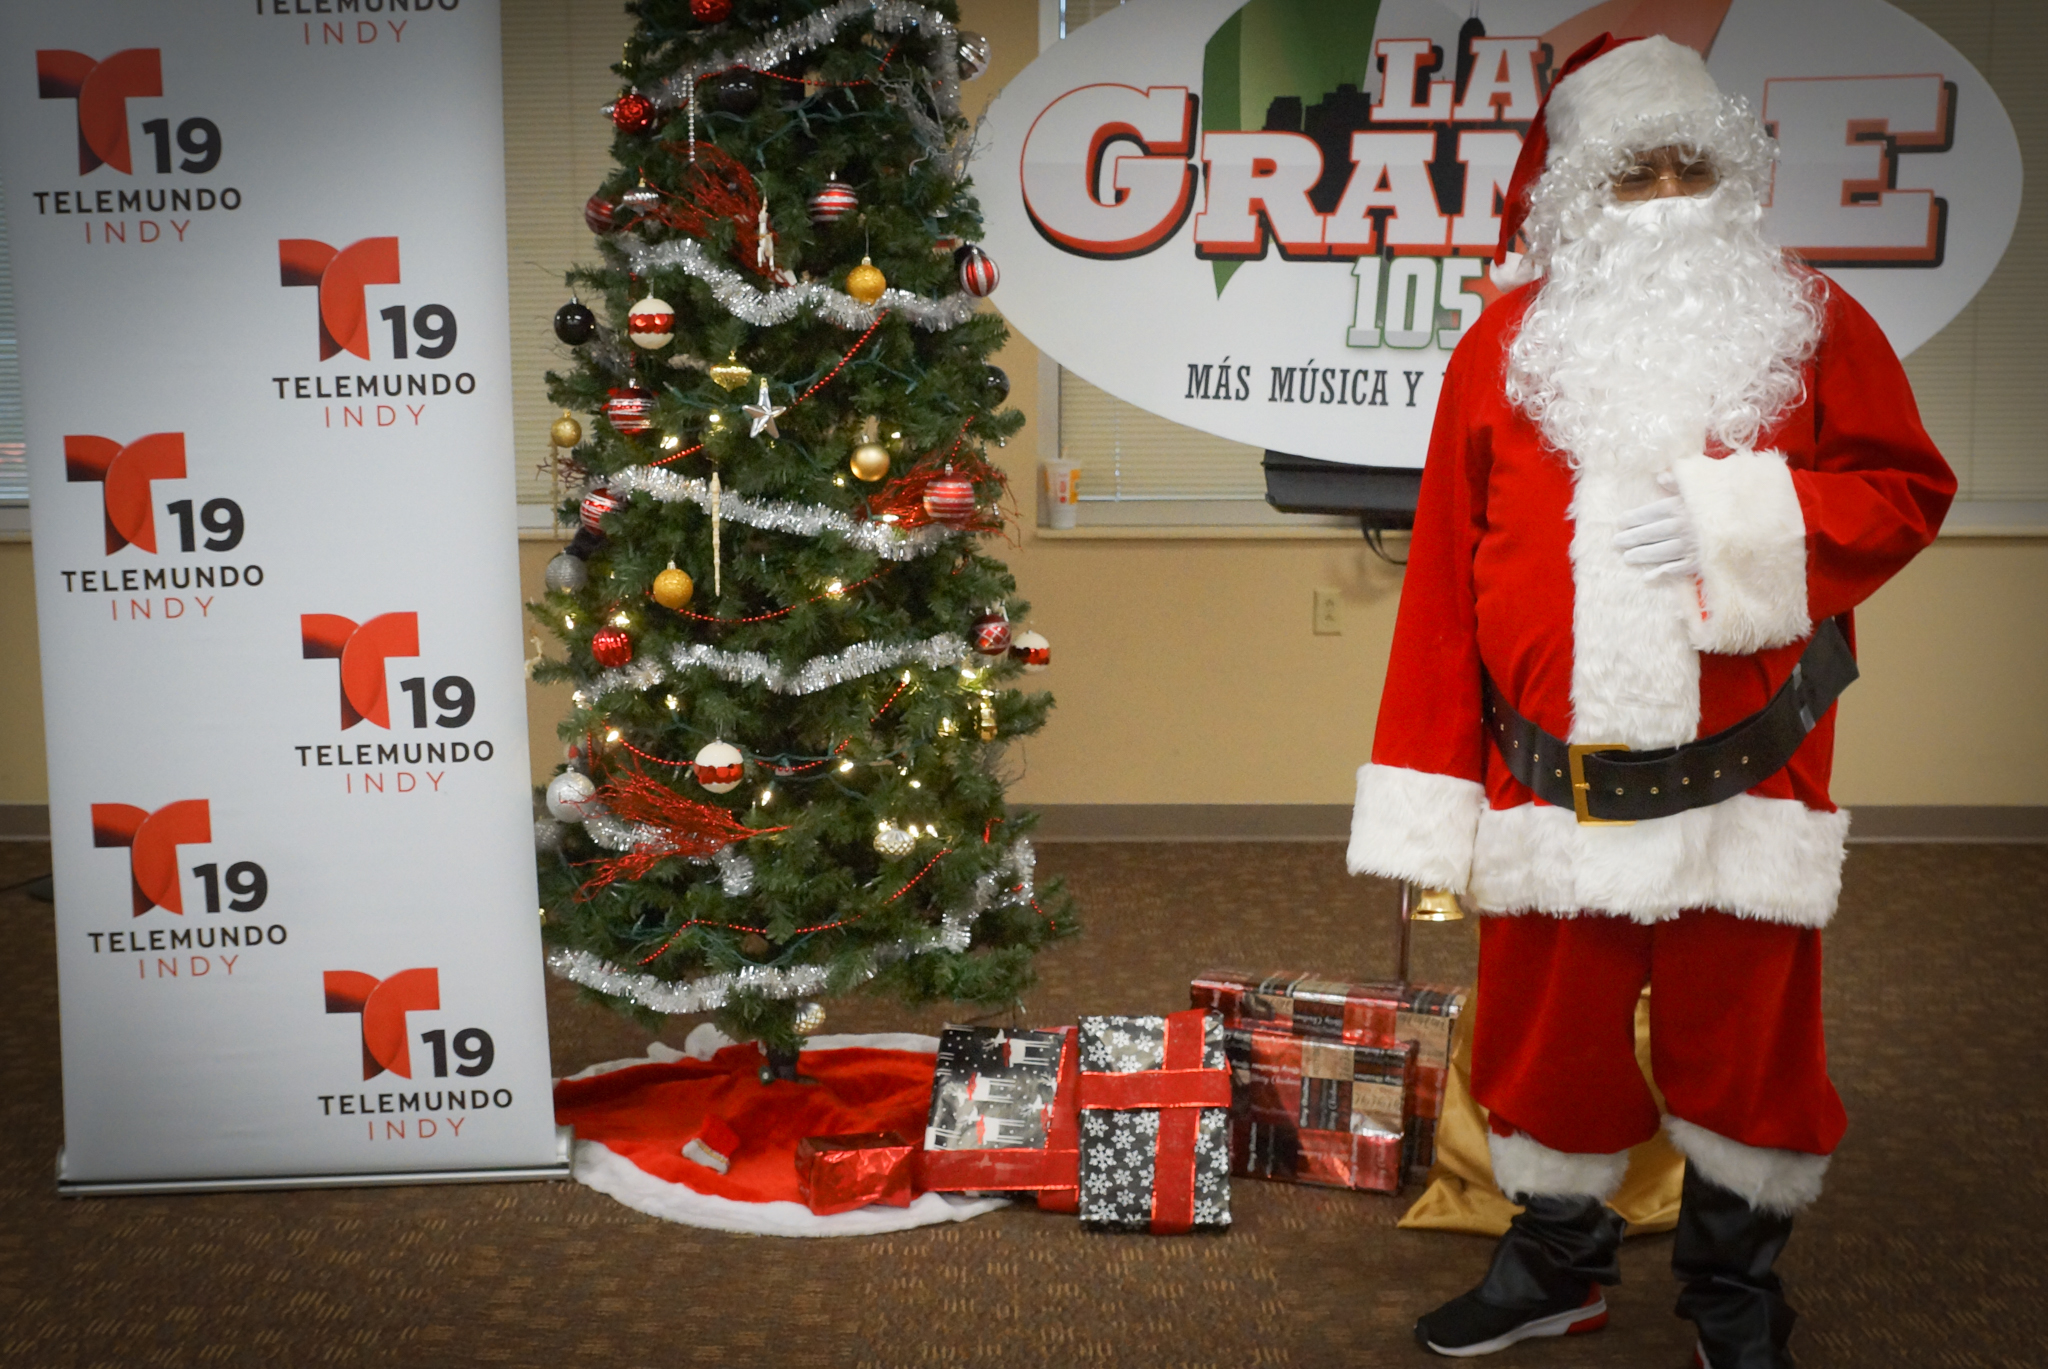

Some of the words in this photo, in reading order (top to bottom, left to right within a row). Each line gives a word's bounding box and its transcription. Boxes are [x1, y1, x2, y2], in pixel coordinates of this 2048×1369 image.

[305, 21, 405, 44] INDY
[1370, 36, 1545, 123] LA
[141, 116, 222, 174] 19
[32, 187, 242, 215] TELEMUNDO
[86, 220, 190, 244] INDY
[379, 303, 458, 360] 19
[271, 372, 476, 400] TELEMUNDO
[1184, 355, 1251, 402] MÁS
[1268, 358, 1389, 407] MÚSICA
[1402, 370, 1424, 408] Y
[325, 404, 425, 428] INDY
[166, 497, 245, 553] 19
[60, 564, 264, 593] TELEMUNDO
[112, 595, 214, 621] INDY
[399, 675, 476, 729] 19
[294, 740, 494, 767] TELEMUNDO
[346, 771, 445, 794] INDY
[192, 860, 268, 914] 19
[87, 924, 287, 954] TELEMUNDO
[139, 955, 238, 979] INDY
[420, 1027, 495, 1078] 19
[317, 1088, 513, 1116] TELEMUNDO
[368, 1117, 465, 1140] INDY
